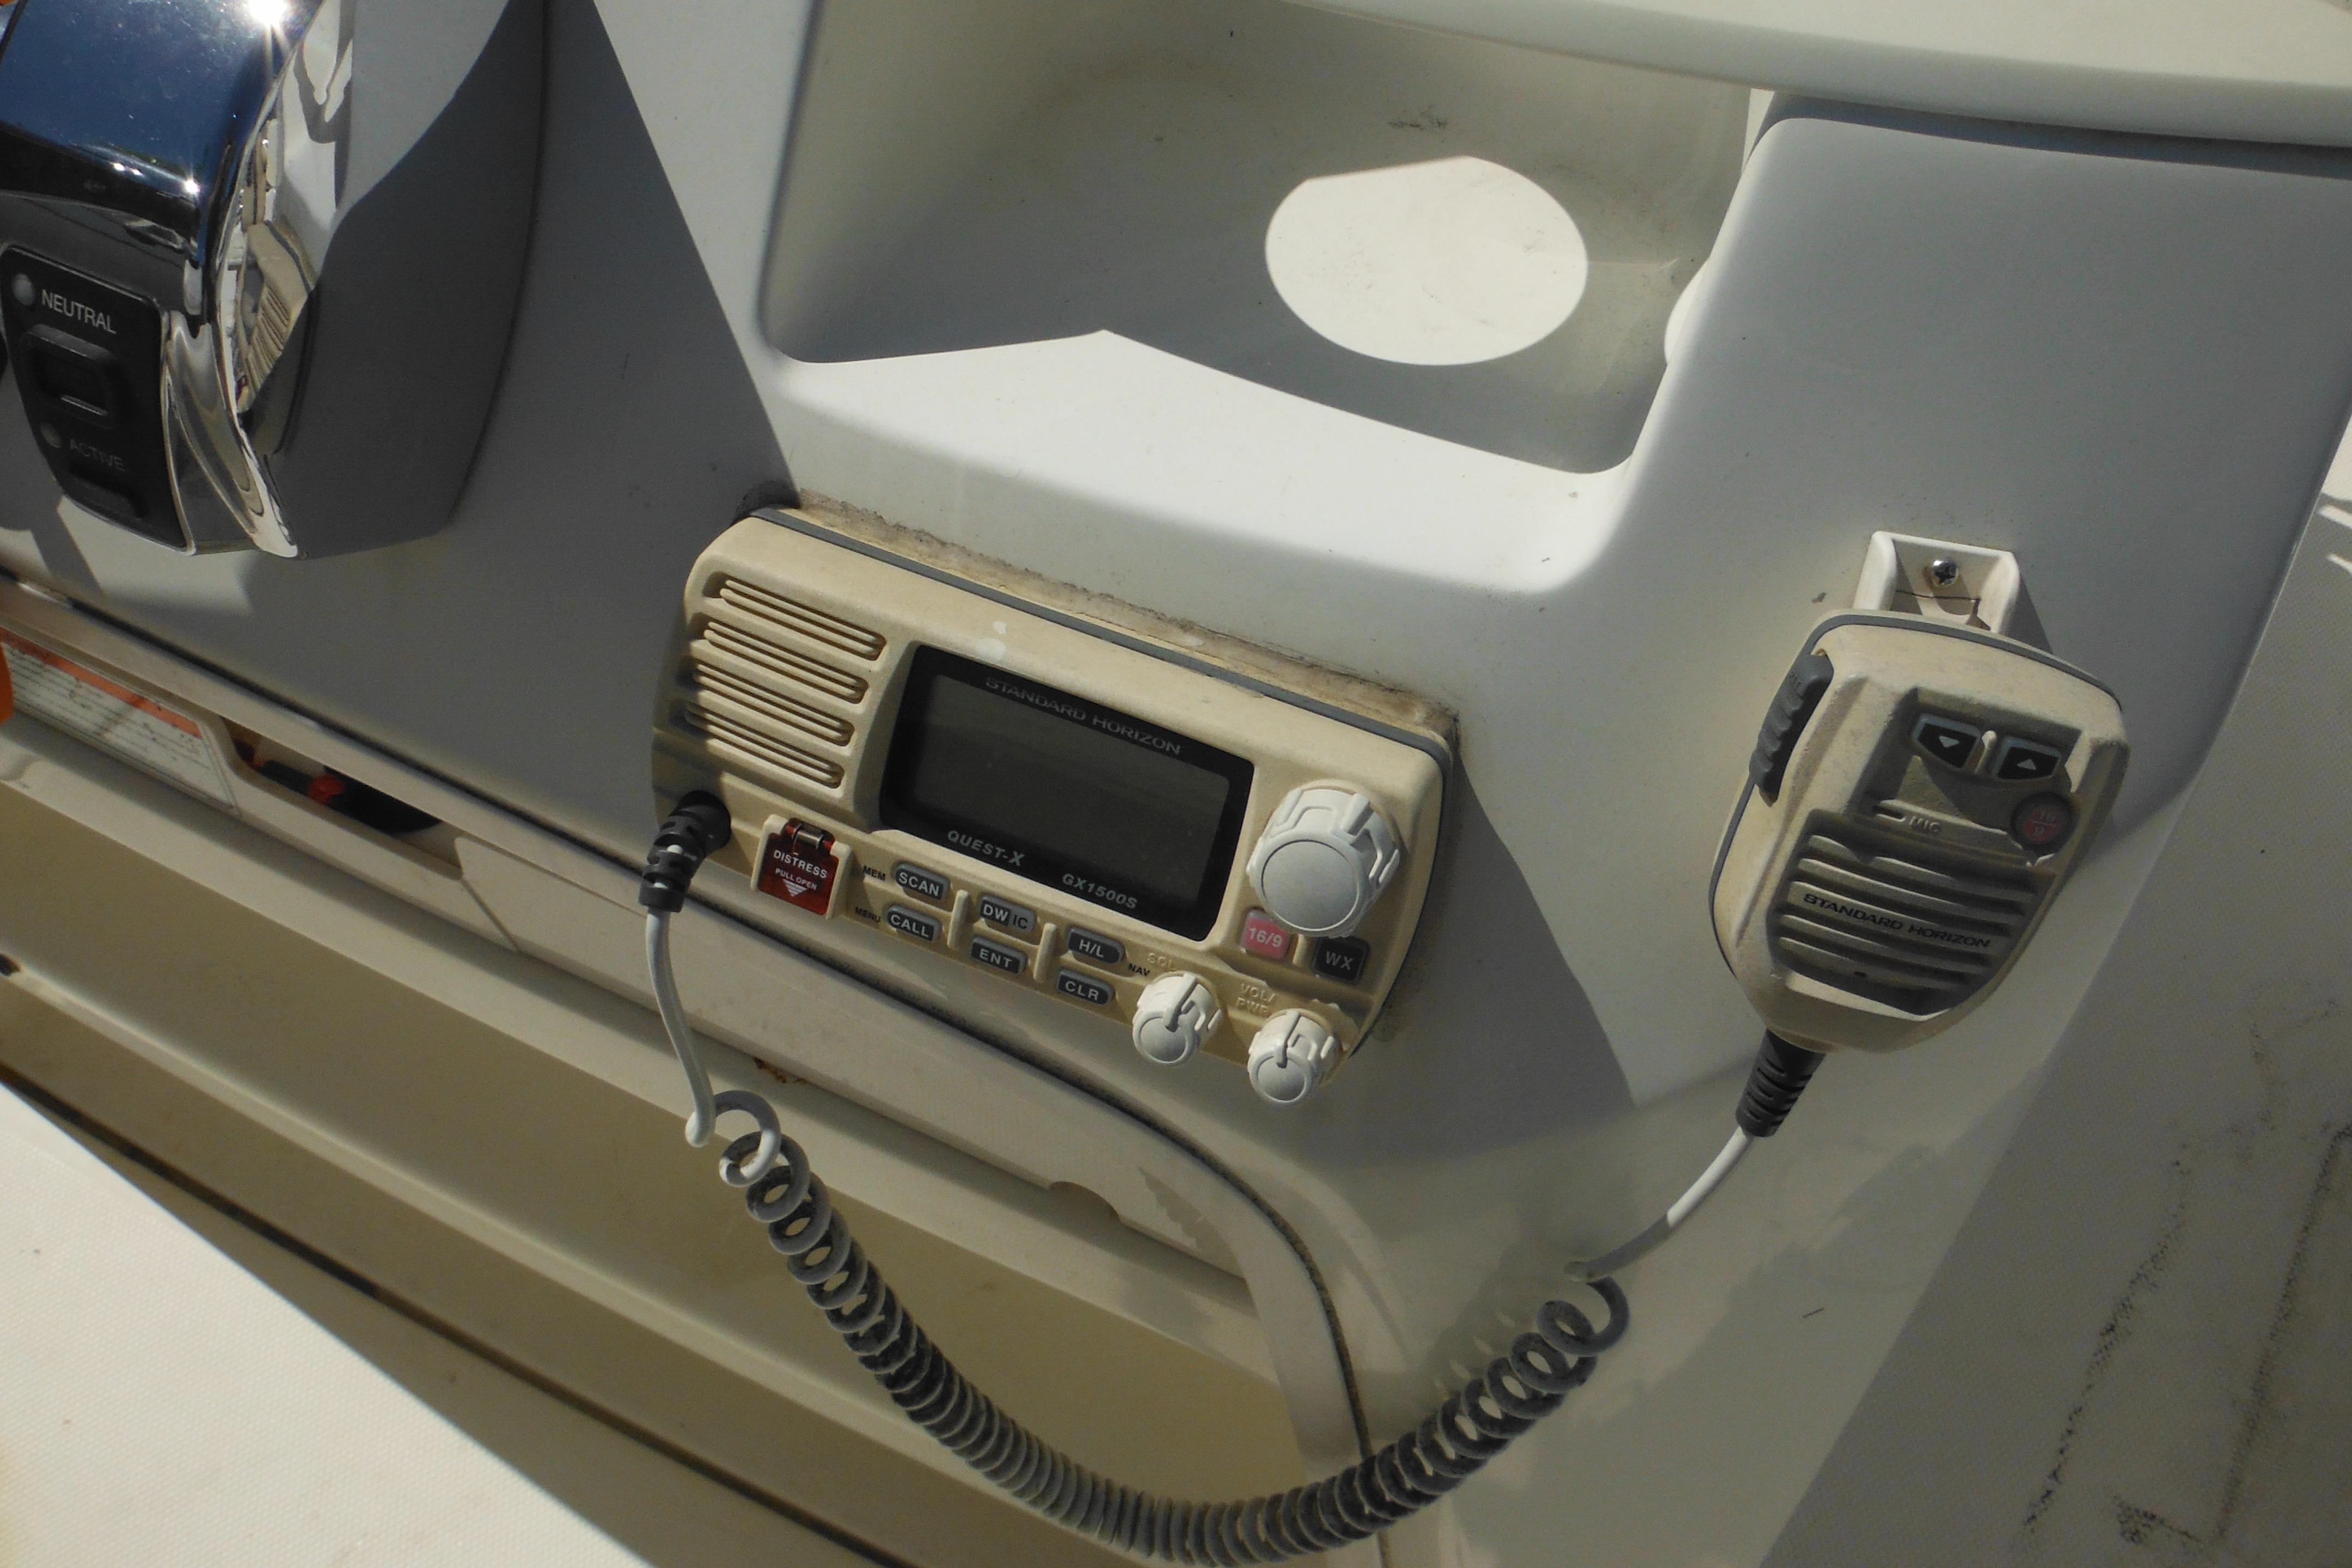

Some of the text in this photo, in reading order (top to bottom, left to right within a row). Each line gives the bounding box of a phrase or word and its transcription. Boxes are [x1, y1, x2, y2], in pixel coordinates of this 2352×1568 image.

[41, 289, 117, 335] NEUTRAL
[985, 677, 1181, 756] STANDARD HORIZON
[1909, 816, 1941, 833] MIC
[947, 830, 1026, 867] QUEST-X
[773, 849, 828, 879] DISTRESS
[863, 865, 886, 881] MEM
[775, 868, 818, 890] PULL OPEN
[898, 872, 940, 897] SCAN
[1062, 873, 1138, 909] GX1500S
[890, 914, 929, 938] CALL
[983, 904, 1028, 929] DW IC
[1803, 893, 1991, 948] STANDARD HORIZON
[1079, 939, 1104, 958] H/L
[1249, 927, 1283, 948] 16/9
[980, 948, 1012, 968] ENT
[1128, 963, 1150, 976] NAV
[1325, 950, 1353, 971] WX
[1065, 981, 1099, 1001] CLR
